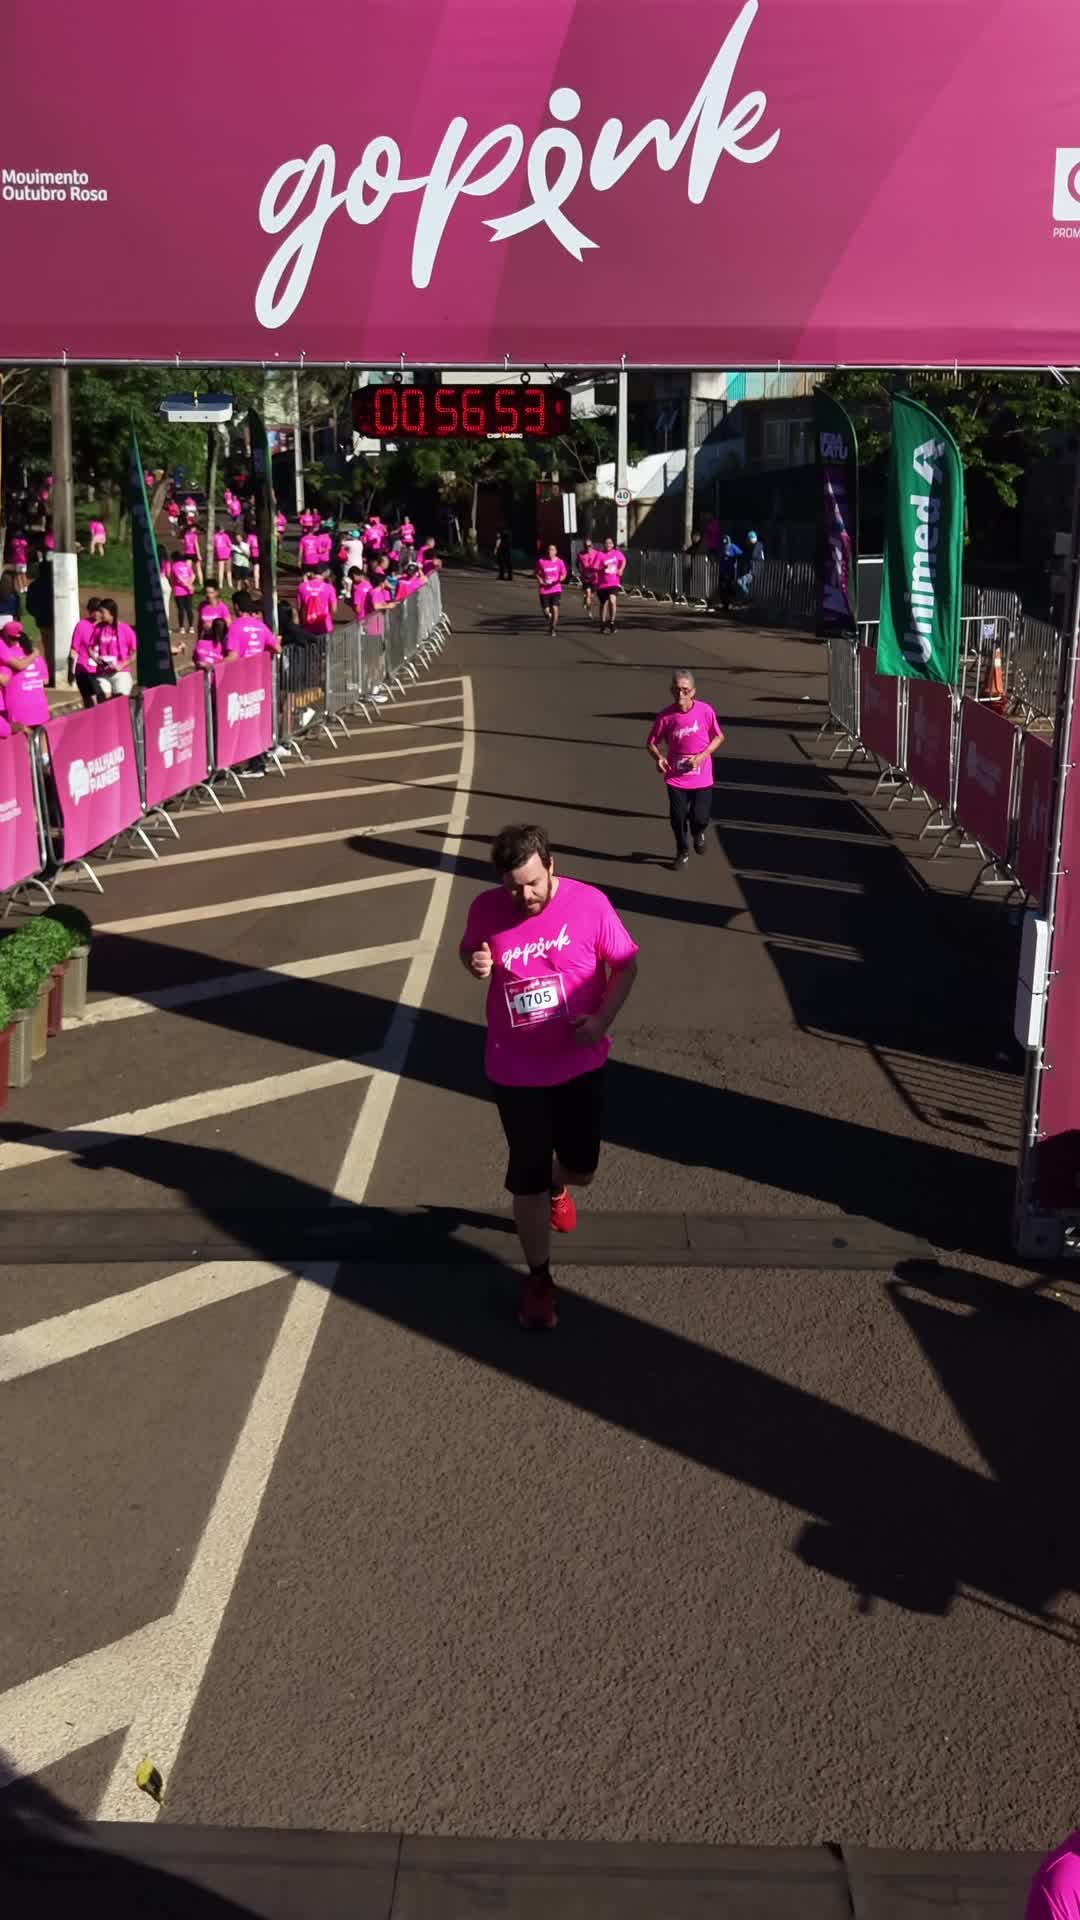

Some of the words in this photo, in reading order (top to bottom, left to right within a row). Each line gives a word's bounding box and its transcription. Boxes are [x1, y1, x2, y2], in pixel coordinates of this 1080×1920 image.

[2, 169, 89, 184] Movimento
[2, 186, 67, 201] Outubro
[70, 187, 108, 201] Rosa
[617, 491, 629, 500] 40
[902, 494, 942, 666] Unimed
[519, 990, 552, 1009] 1705
